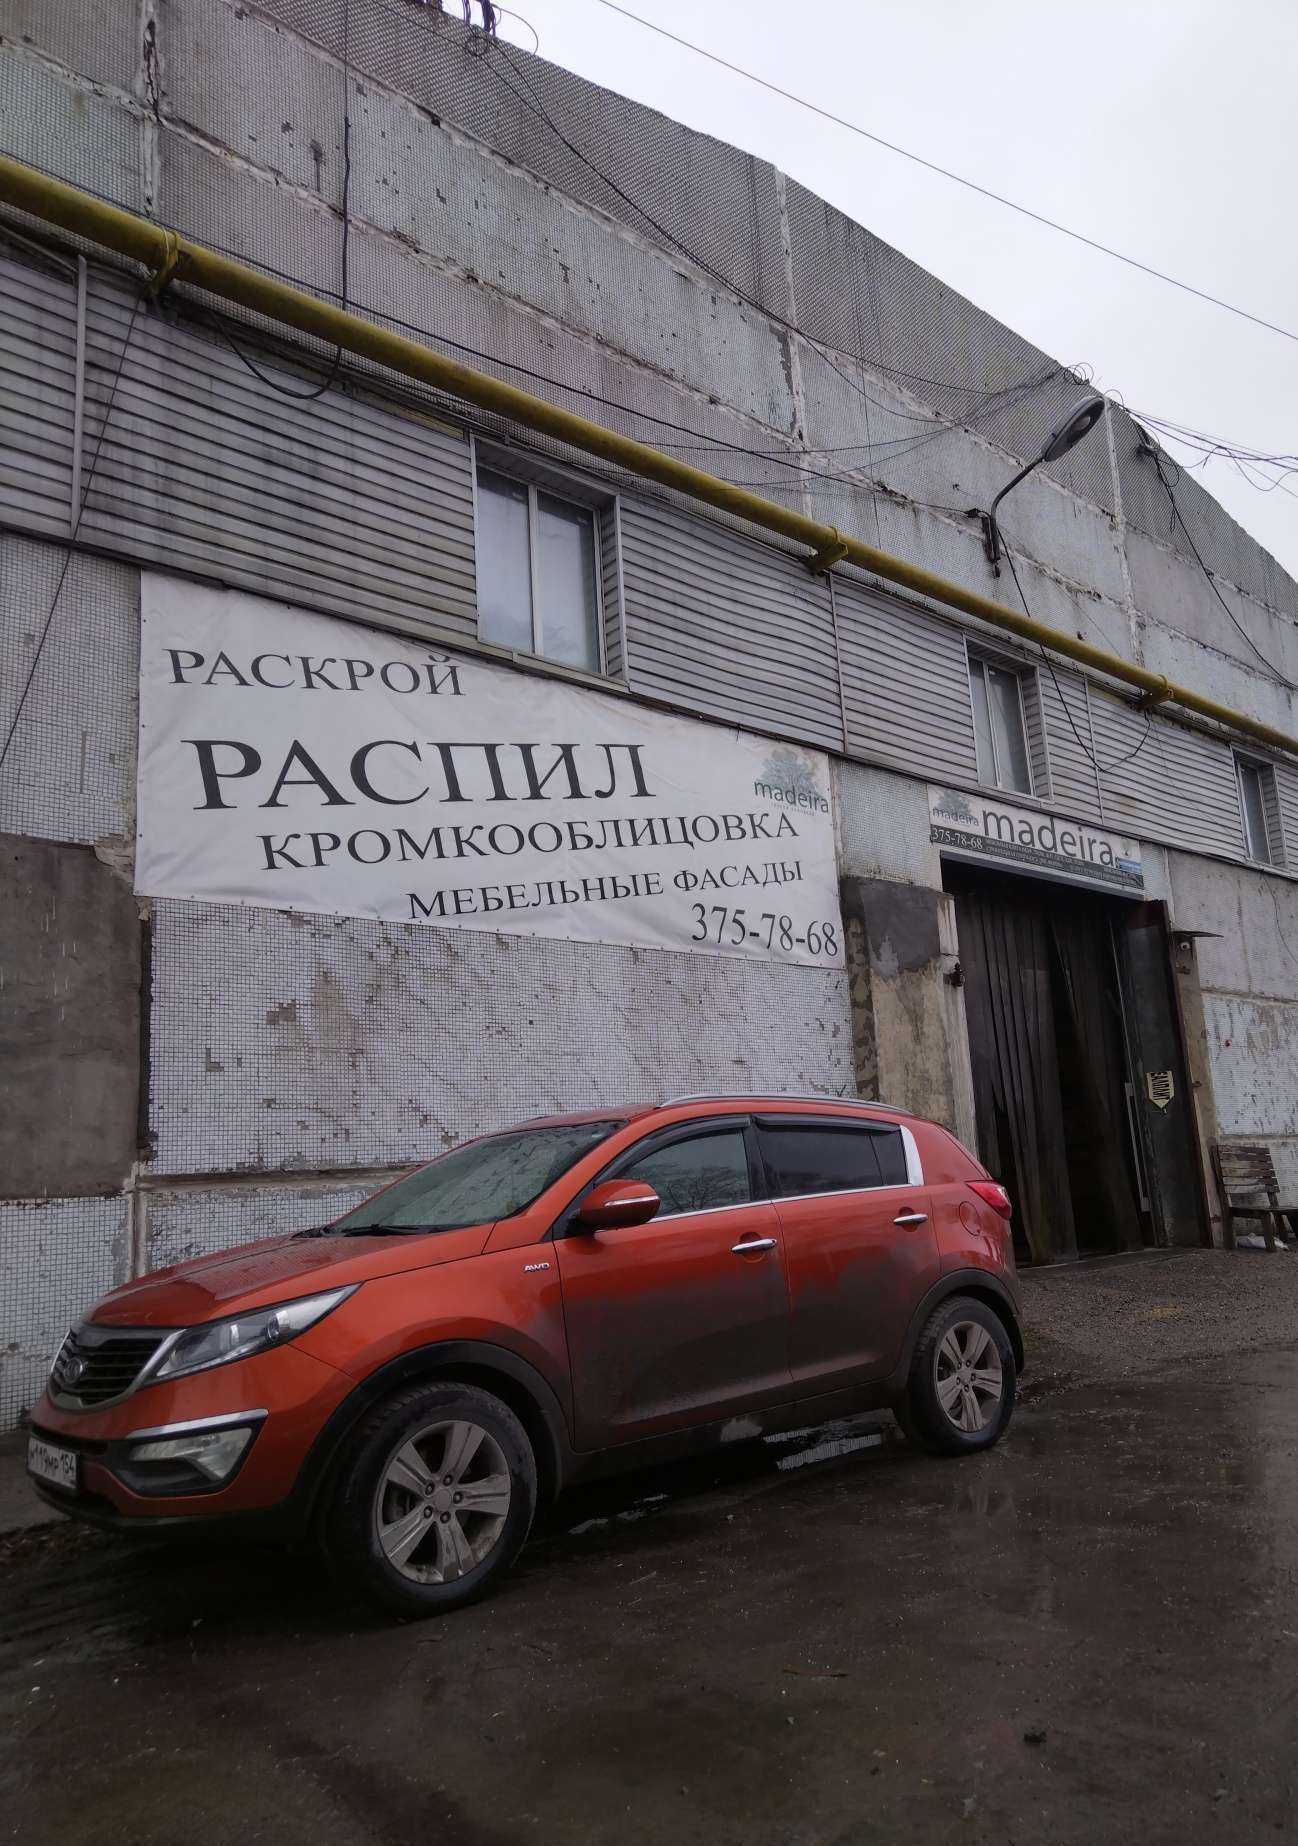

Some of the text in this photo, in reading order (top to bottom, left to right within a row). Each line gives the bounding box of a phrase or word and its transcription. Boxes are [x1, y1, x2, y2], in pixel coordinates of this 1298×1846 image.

[163, 648, 466, 697] РАСКРОЙ
[180, 738, 657, 811] РАСПИЛ
[754, 780, 829, 813] madeira
[255, 811, 800, 871] КРОМКООБЛИЦОВКА
[931, 827, 983, 849] 375-78-68
[982, 808, 1114, 867] madeira
[405, 859, 804, 920] МЕБЕЛЬНЫЕ ФАСАДЫ
[691, 902, 839, 957] 375-78-68
[524, 1262, 550, 1272] AWD
